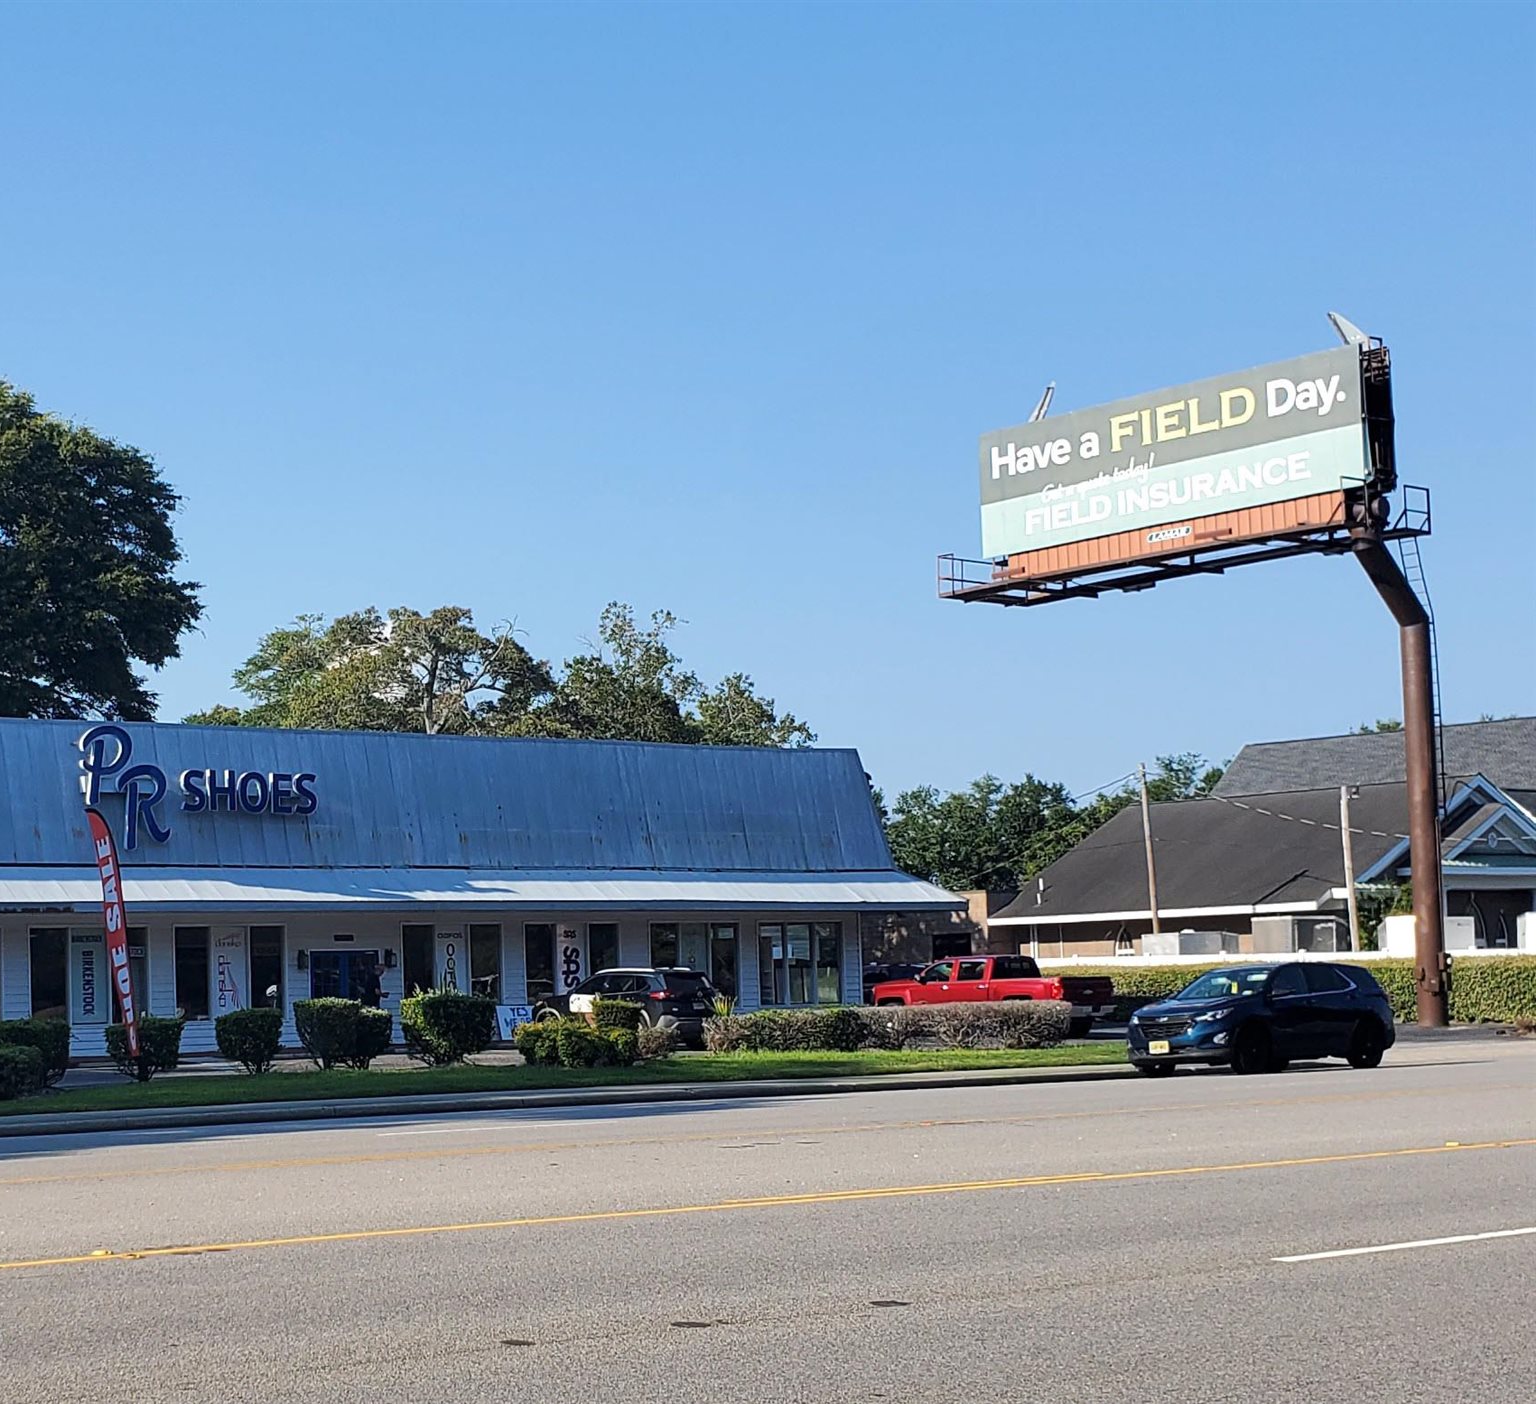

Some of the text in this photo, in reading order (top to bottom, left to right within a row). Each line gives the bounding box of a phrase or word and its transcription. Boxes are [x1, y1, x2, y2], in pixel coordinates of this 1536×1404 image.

[991, 374, 1347, 480] Have a FIELD Day.
[1024, 450, 1313, 536] FIELD INSURANCE
[1113, 452, 1156, 483] today!
[180, 768, 319, 816] SHOES
[95, 836, 122, 933] SALE
[81, 950, 95, 1016] BIRKENSTOCK
[561, 945, 581, 988] SAS
[509, 1007, 529, 1017] YES
